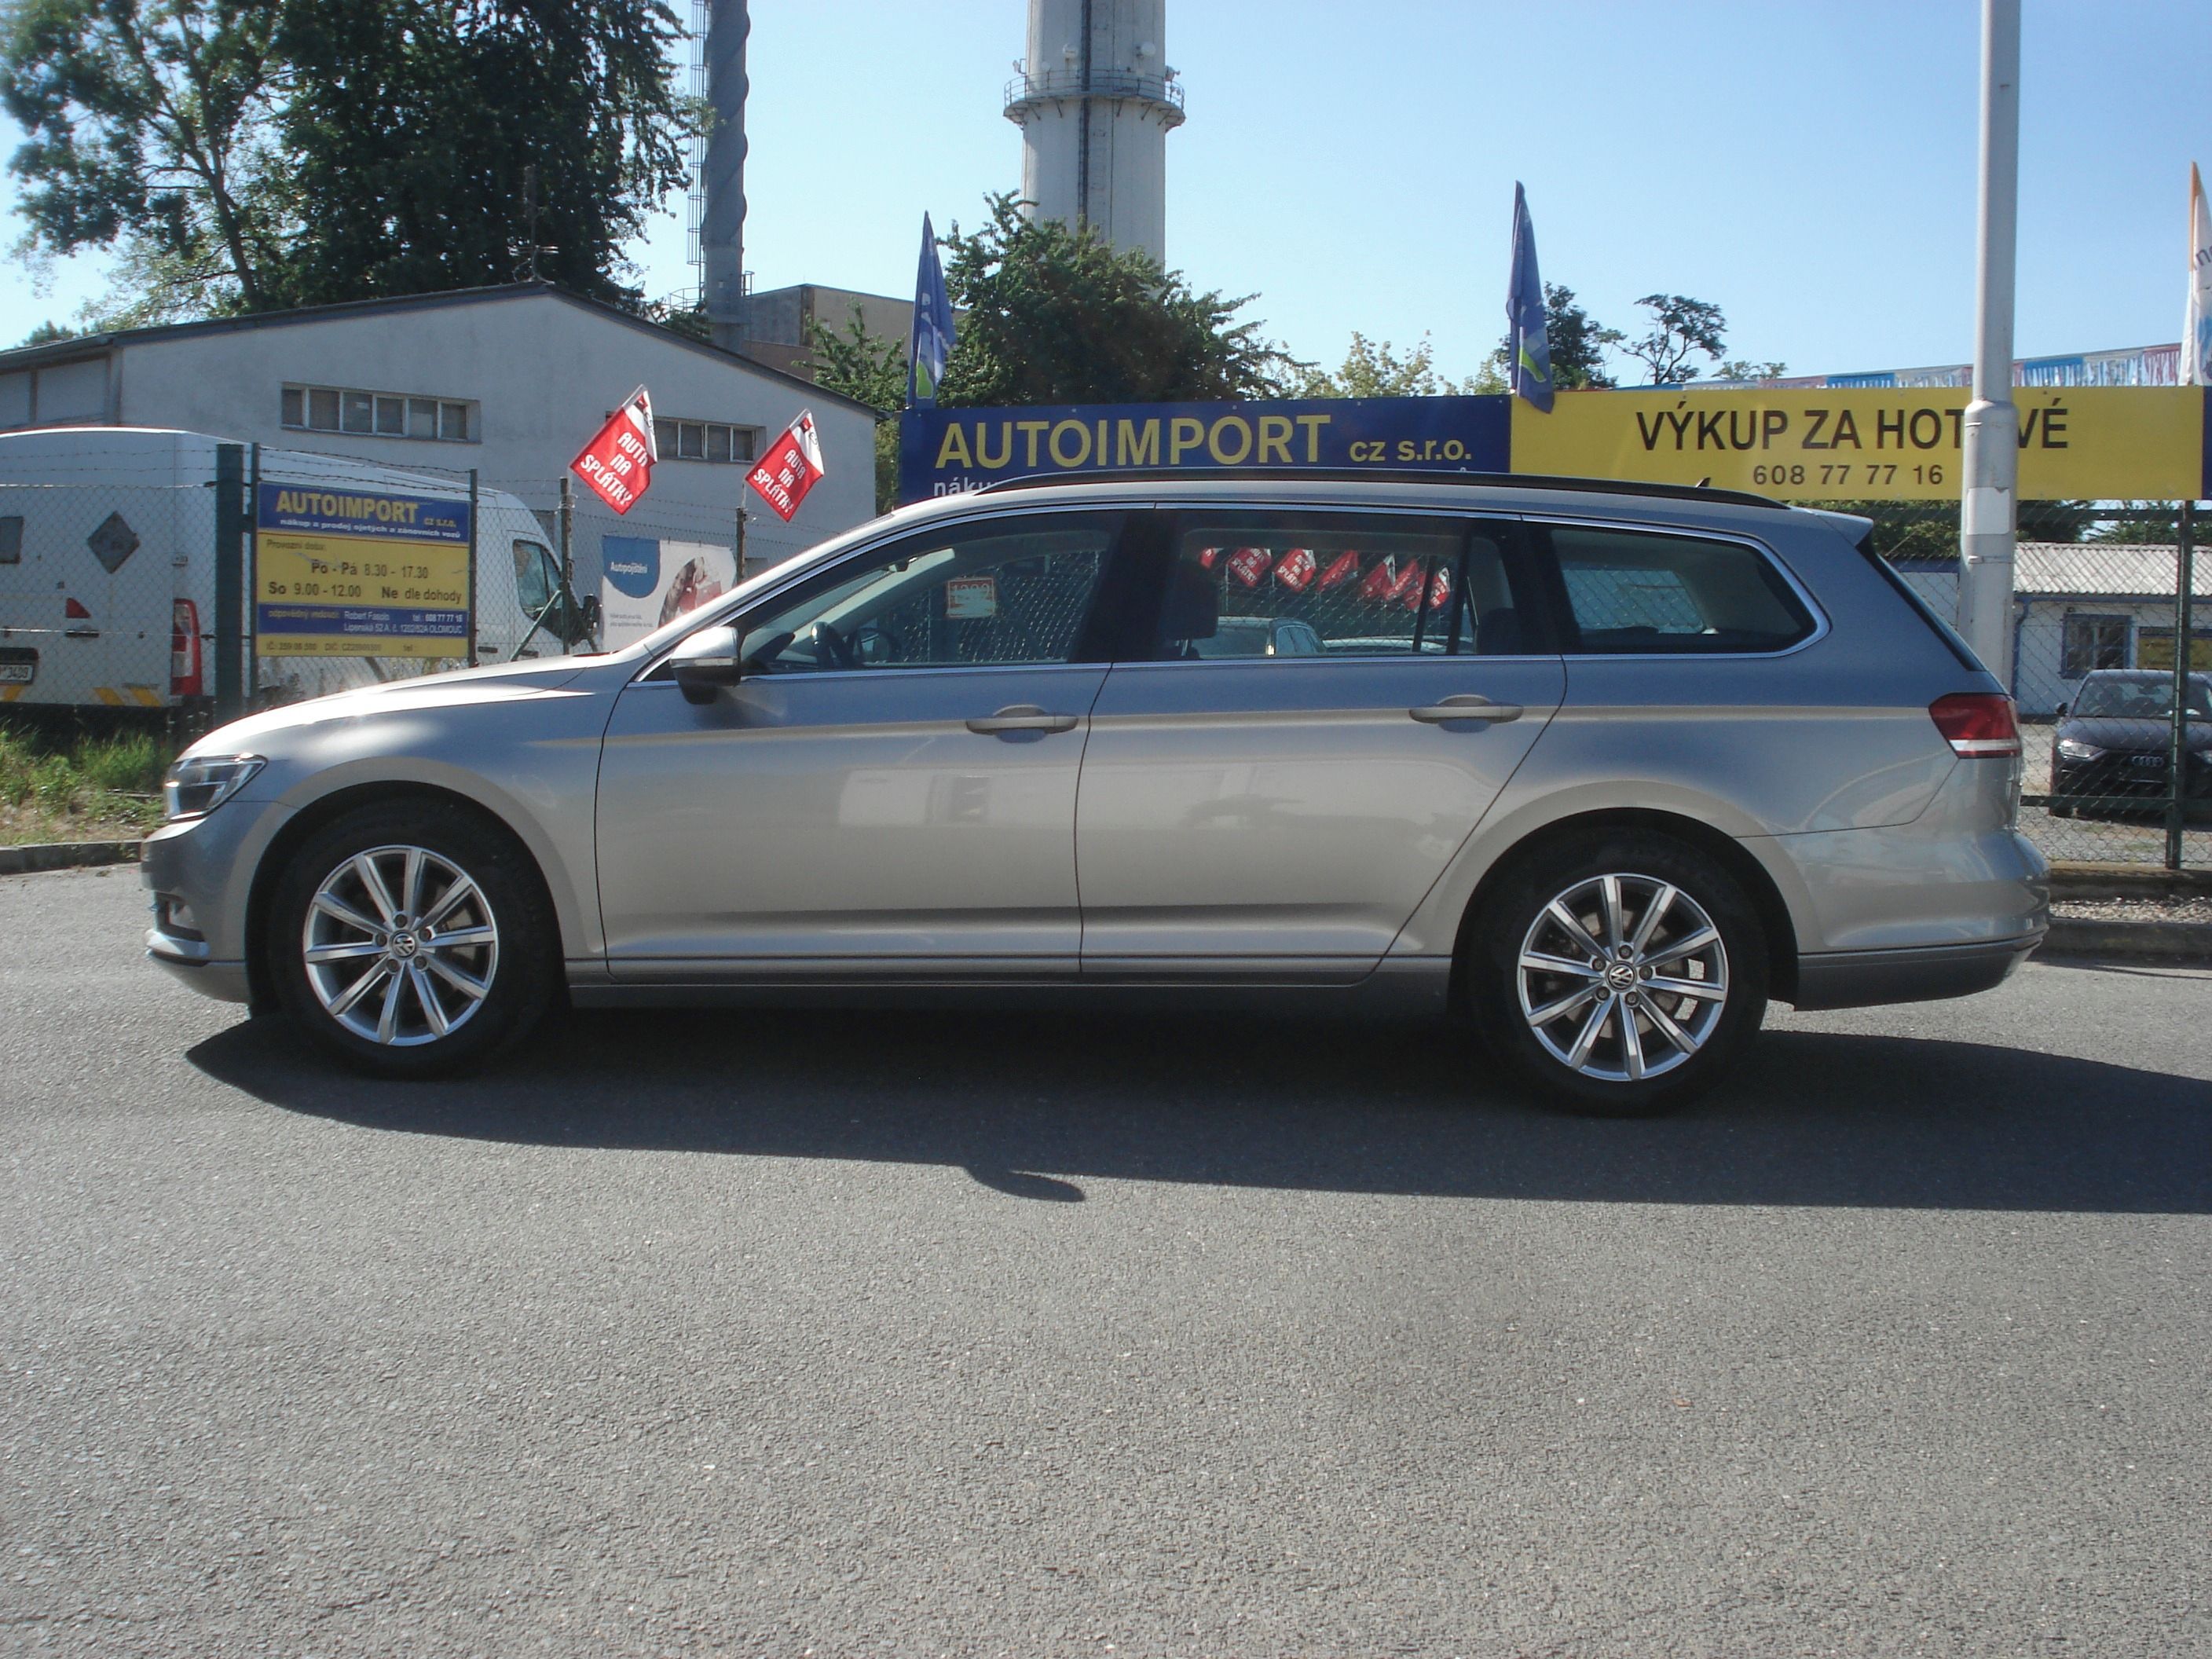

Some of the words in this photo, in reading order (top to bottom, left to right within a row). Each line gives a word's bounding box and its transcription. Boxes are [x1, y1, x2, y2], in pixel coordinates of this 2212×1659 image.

[1635, 401, 1789, 450] VÝKUP
[1801, 409, 1862, 449] ZA
[1877, 398, 2068, 449] HOTVÉ
[935, 415, 1331, 469] AUTOIMPORT
[1349, 441, 1386, 462] cz
[1397, 439, 1472, 462] s.r.o.
[580, 453, 633, 505] SPLÁTKY
[610, 453, 632, 477] NA
[778, 467, 795, 489] NA
[784, 449, 807, 480] AUTA
[1753, 464, 1806, 485] 608
[1820, 464, 1851, 485] 77
[1866, 464, 1898, 485] 77
[1913, 463, 1943, 485] 16
[753, 468, 794, 513] SPLÁTKY
[276, 489, 419, 524] AUTOIMPORT
[311, 559, 328, 574] Po
[340, 562, 357, 576] Pá
[364, 562, 388, 577] 8.30
[401, 565, 429, 579] 17.30
[268, 581, 287, 595] So
[294, 582, 320, 596] 9.00
[331, 584, 362, 597] 12.00
[381, 586, 399, 599] Ne
[405, 587, 421, 600] dle
[423, 588, 463, 605] dohody
